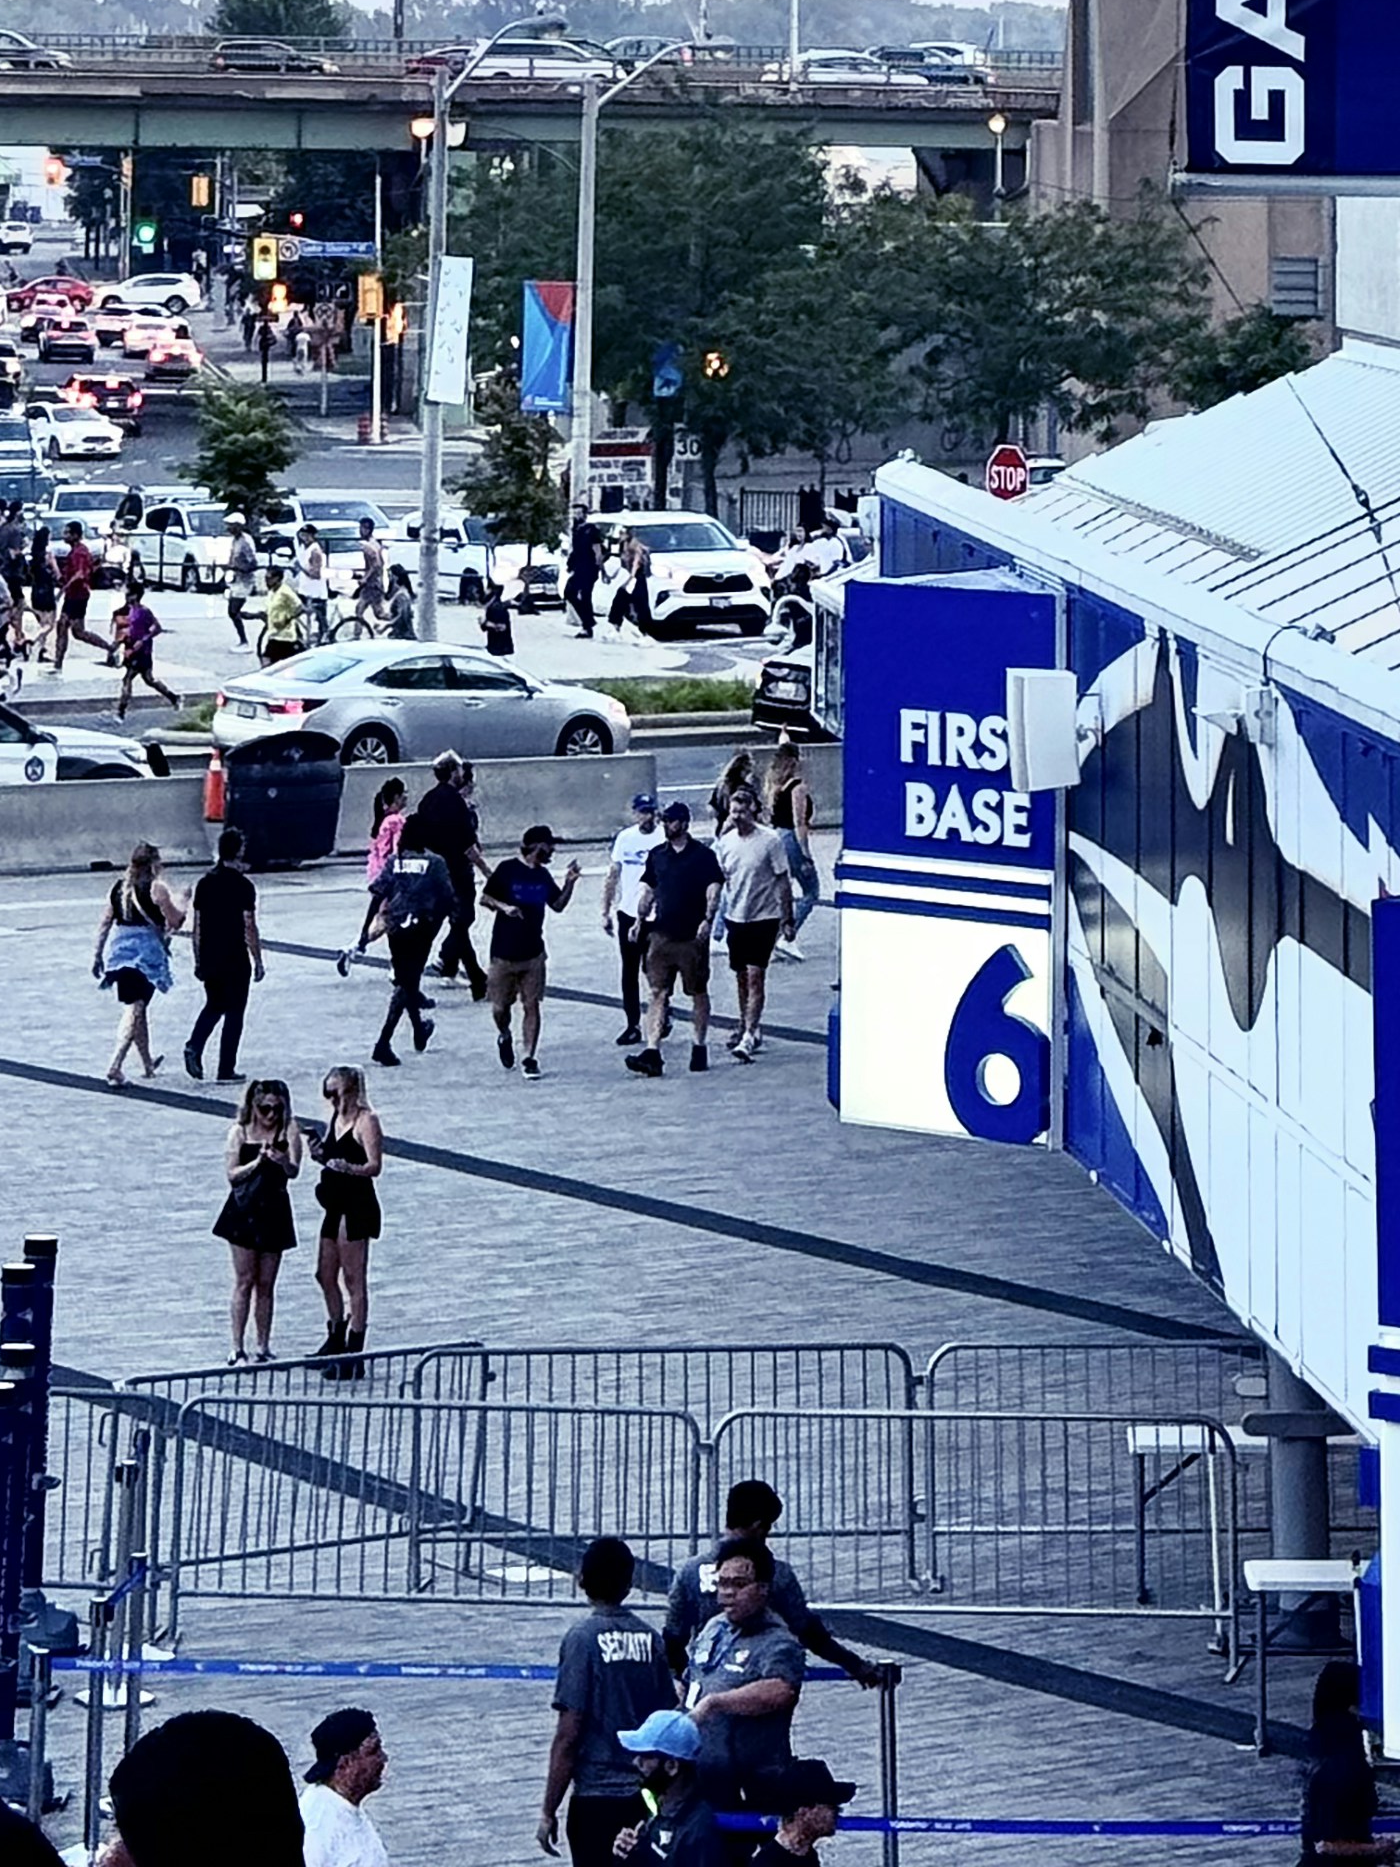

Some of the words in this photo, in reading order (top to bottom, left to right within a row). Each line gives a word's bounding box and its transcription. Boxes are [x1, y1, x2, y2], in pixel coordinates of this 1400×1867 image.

[677, 438, 701, 456] 30
[990, 464, 1026, 492] STOP
[900, 708, 1010, 772] FIRS
[905, 781, 1032, 849] BASE
[945, 943, 1050, 1144] 6
